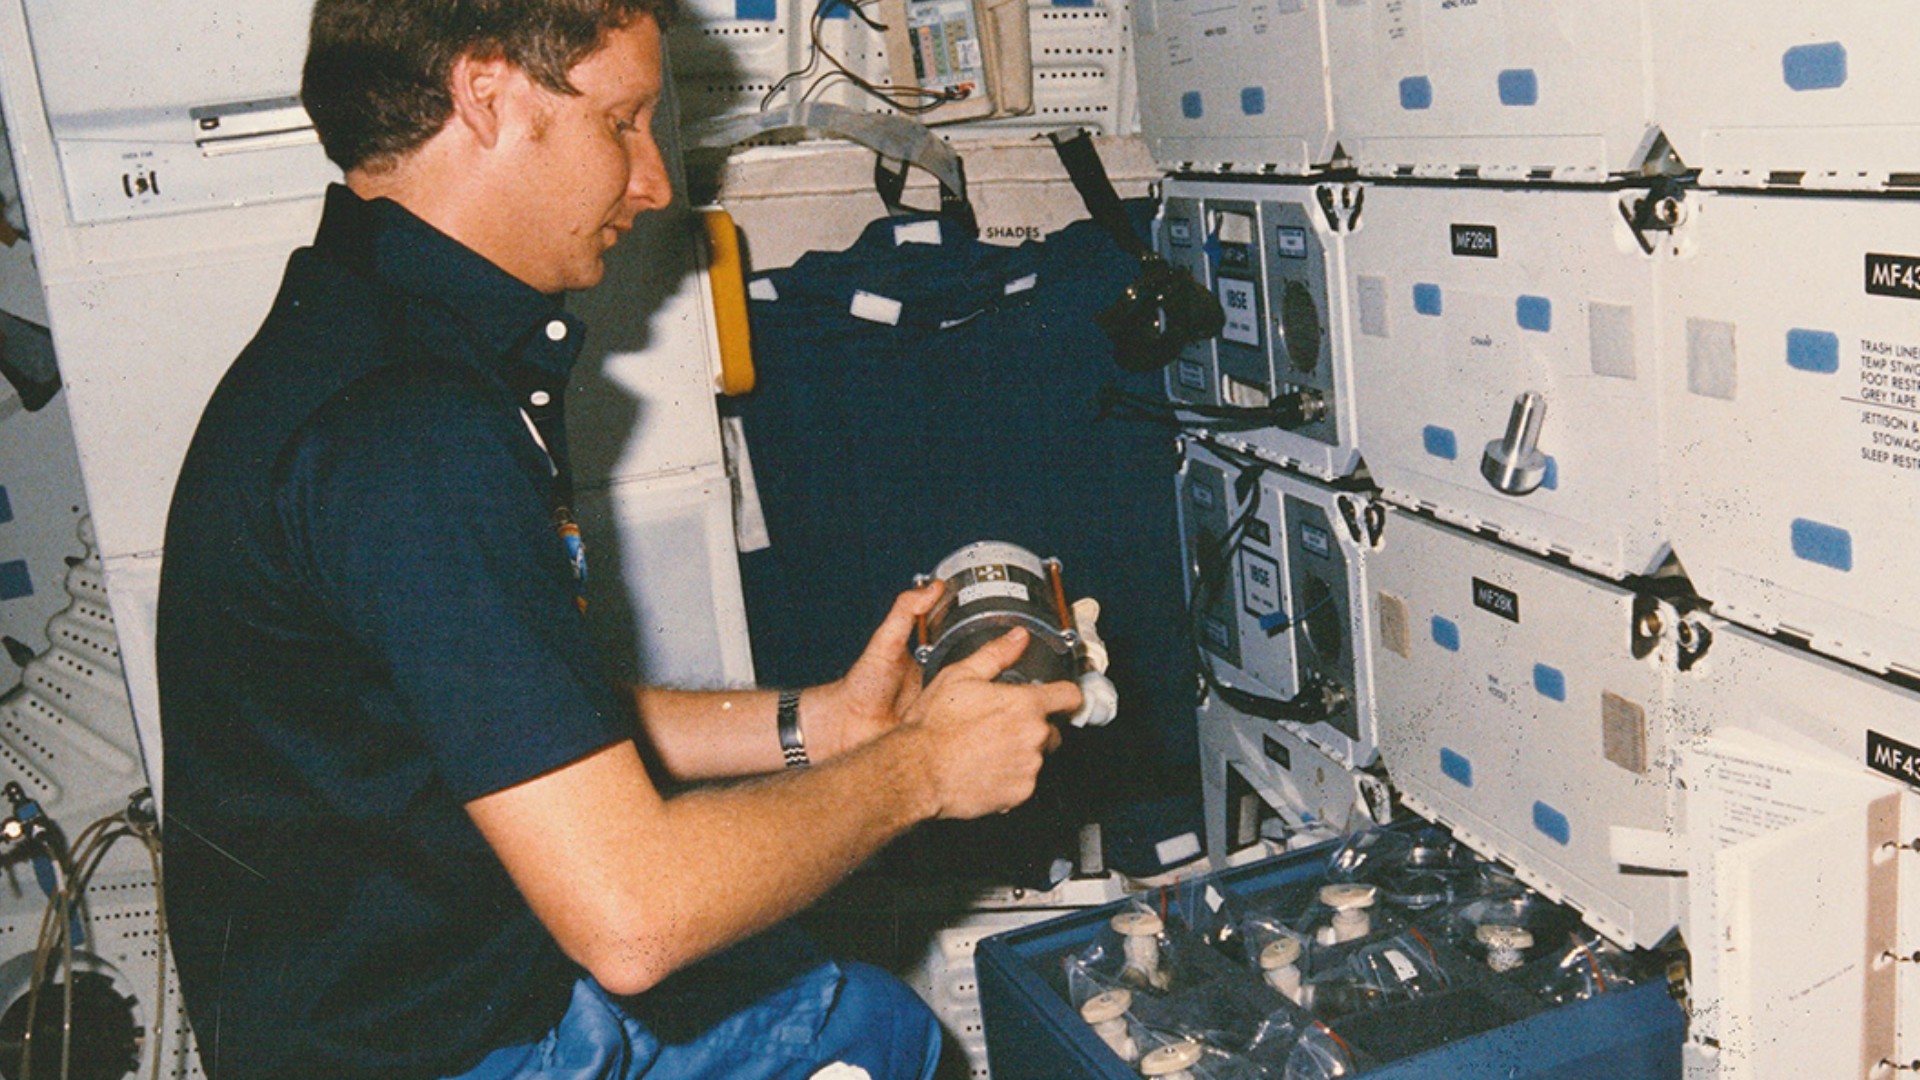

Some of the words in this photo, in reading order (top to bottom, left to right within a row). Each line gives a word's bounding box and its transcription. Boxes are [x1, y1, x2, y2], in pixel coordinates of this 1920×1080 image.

[987, 226, 1040, 238] SHADES
[1872, 263, 1920, 290] MF43
[1861, 339, 1892, 355] TRASH
[1896, 345, 1920, 359] LINE
[1861, 355, 1886, 370] TEMP
[1861, 371, 1888, 387] FOOT
[1861, 387, 1888, 402] GREY
[1891, 391, 1916, 408] TAPE
[1861, 411, 1908, 430] JETTISON
[1911, 420, 1919, 433] &
[1873, 431, 1920, 452] STOWAG
[1861, 447, 1889, 463] SLEEP
